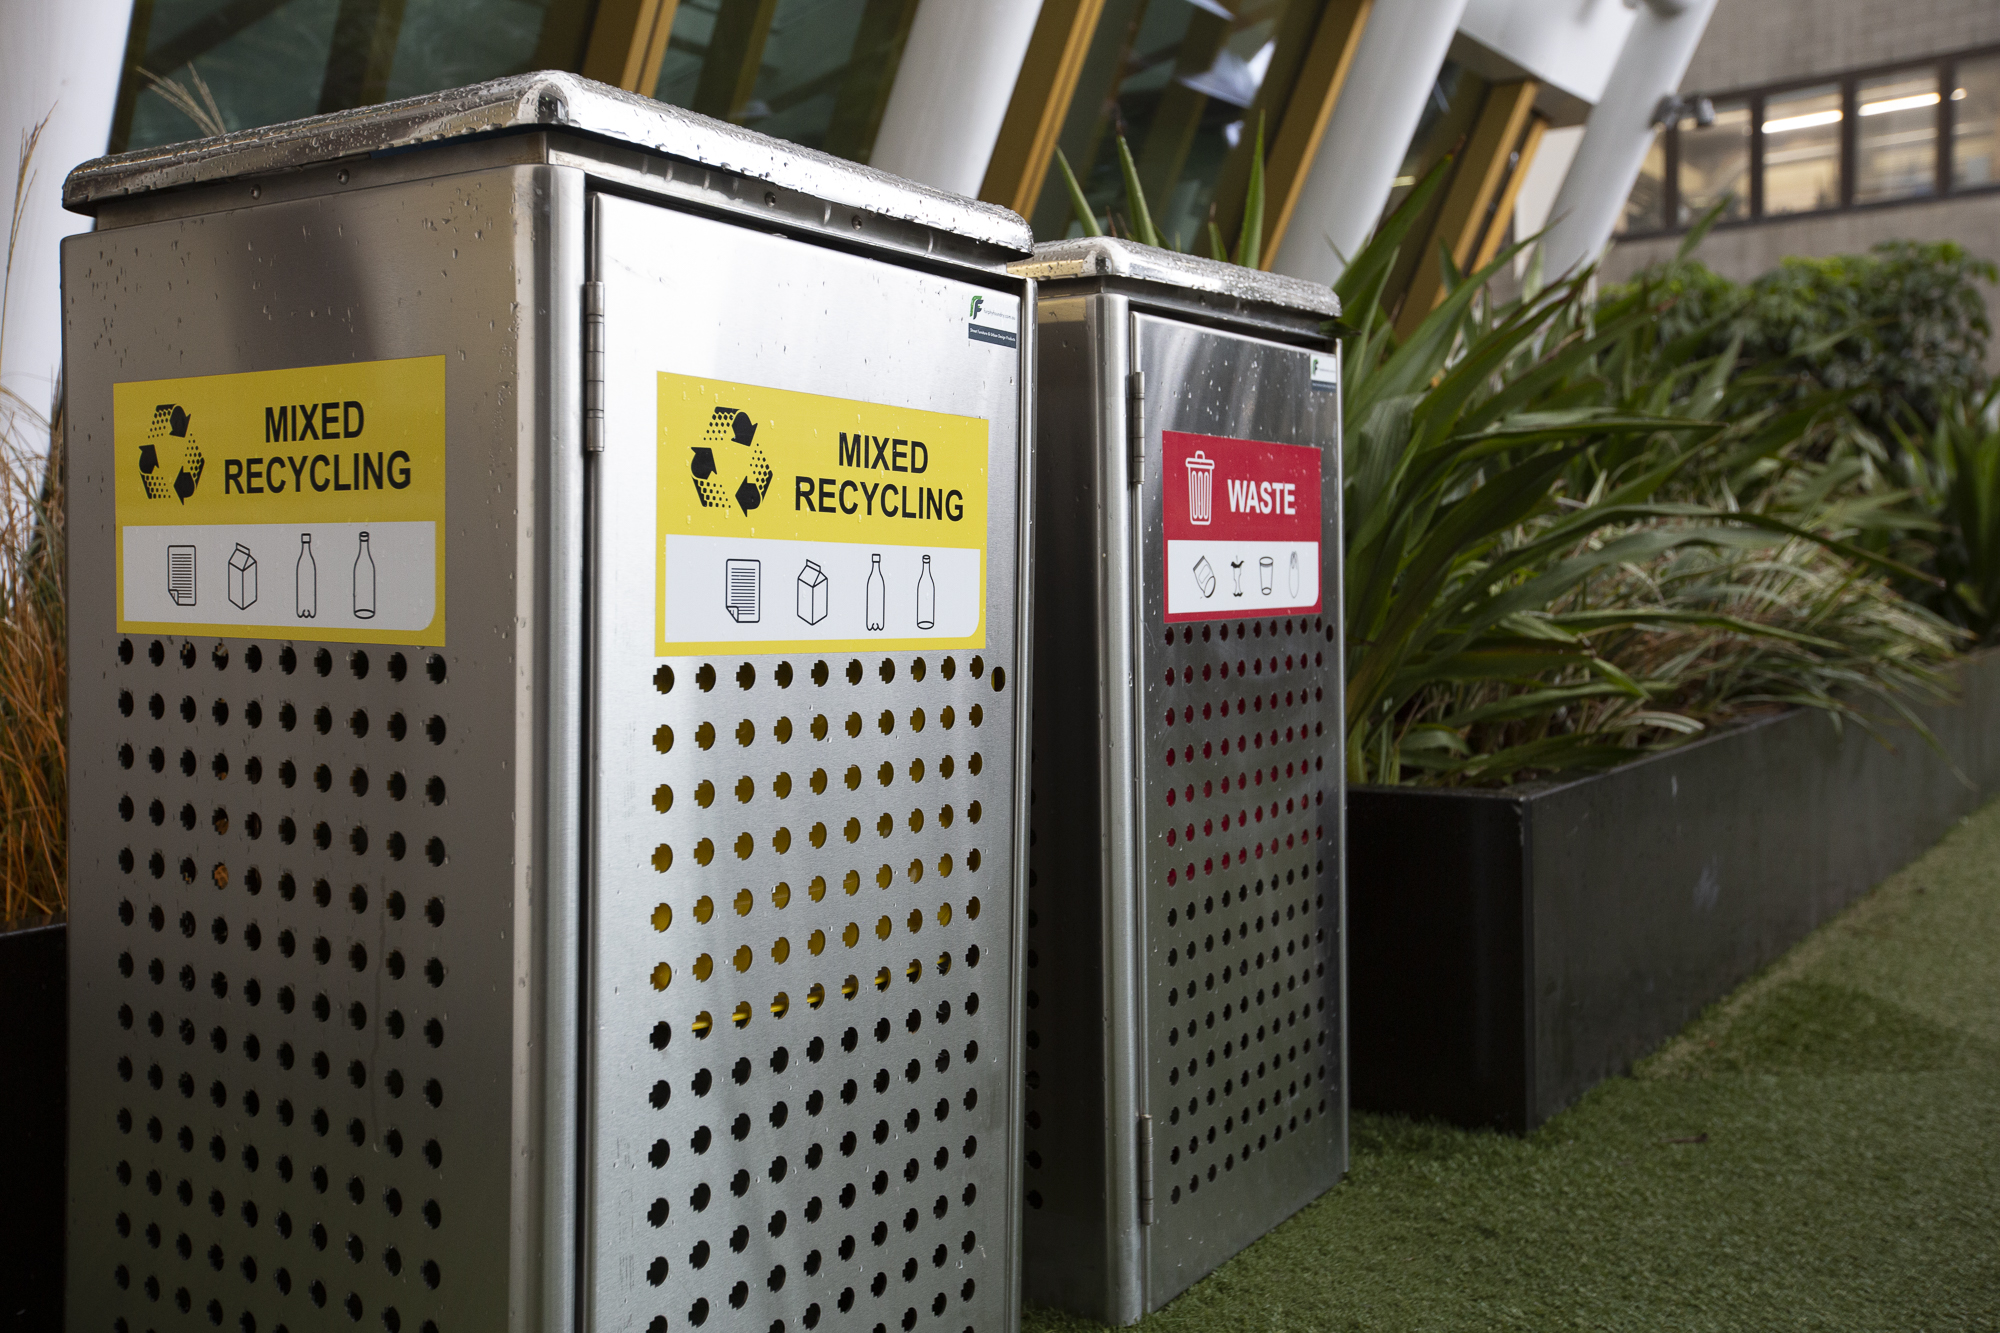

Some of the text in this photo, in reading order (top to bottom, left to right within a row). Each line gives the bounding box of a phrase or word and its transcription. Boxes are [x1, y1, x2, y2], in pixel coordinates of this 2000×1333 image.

[265, 401, 364, 443] MIXED
[224, 450, 411, 495] RECYCLING
[838, 432, 929, 474] MIXED
[795, 476, 964, 522] RECYCLING
[1227, 479, 1296, 515] WASTE
